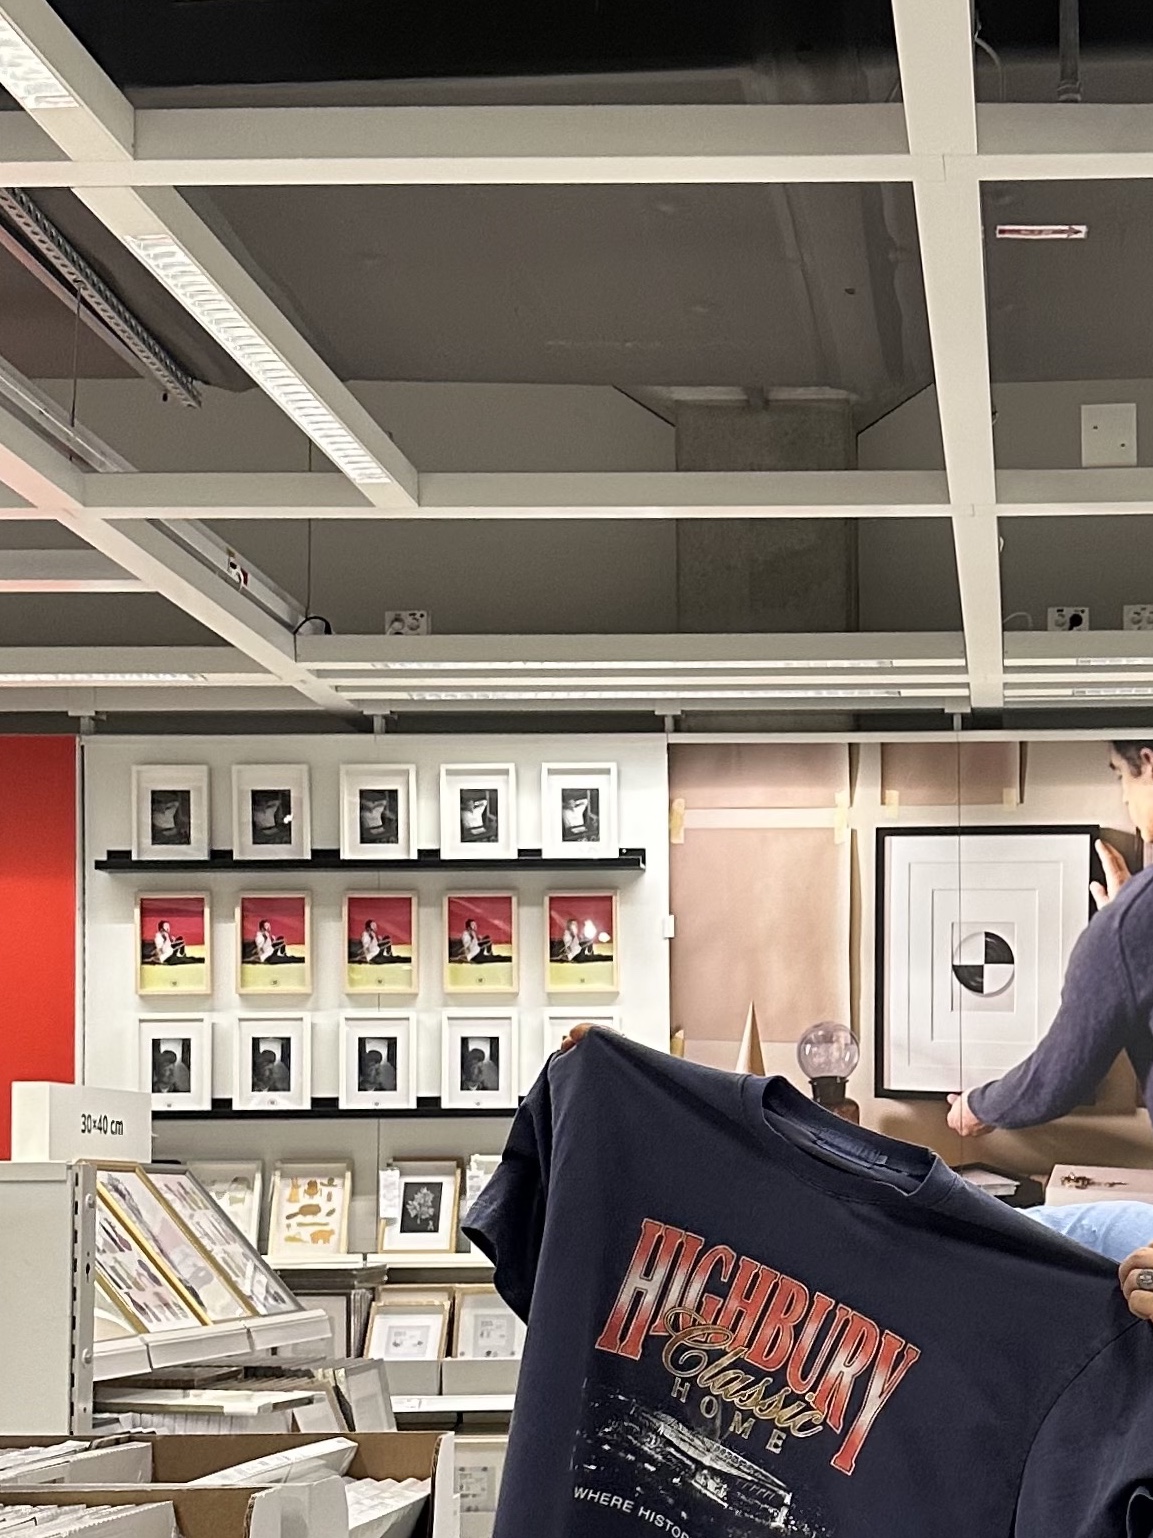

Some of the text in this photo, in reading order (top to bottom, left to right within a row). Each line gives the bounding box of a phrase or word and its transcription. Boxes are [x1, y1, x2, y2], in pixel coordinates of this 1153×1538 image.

[110, 1119, 124, 1136] cm
[595, 1217, 922, 1476] HIGHBURY
[662, 1305, 824, 1438] Classic
[670, 1376, 788, 1454] HOME
[573, 1486, 635, 1513] WHERE
